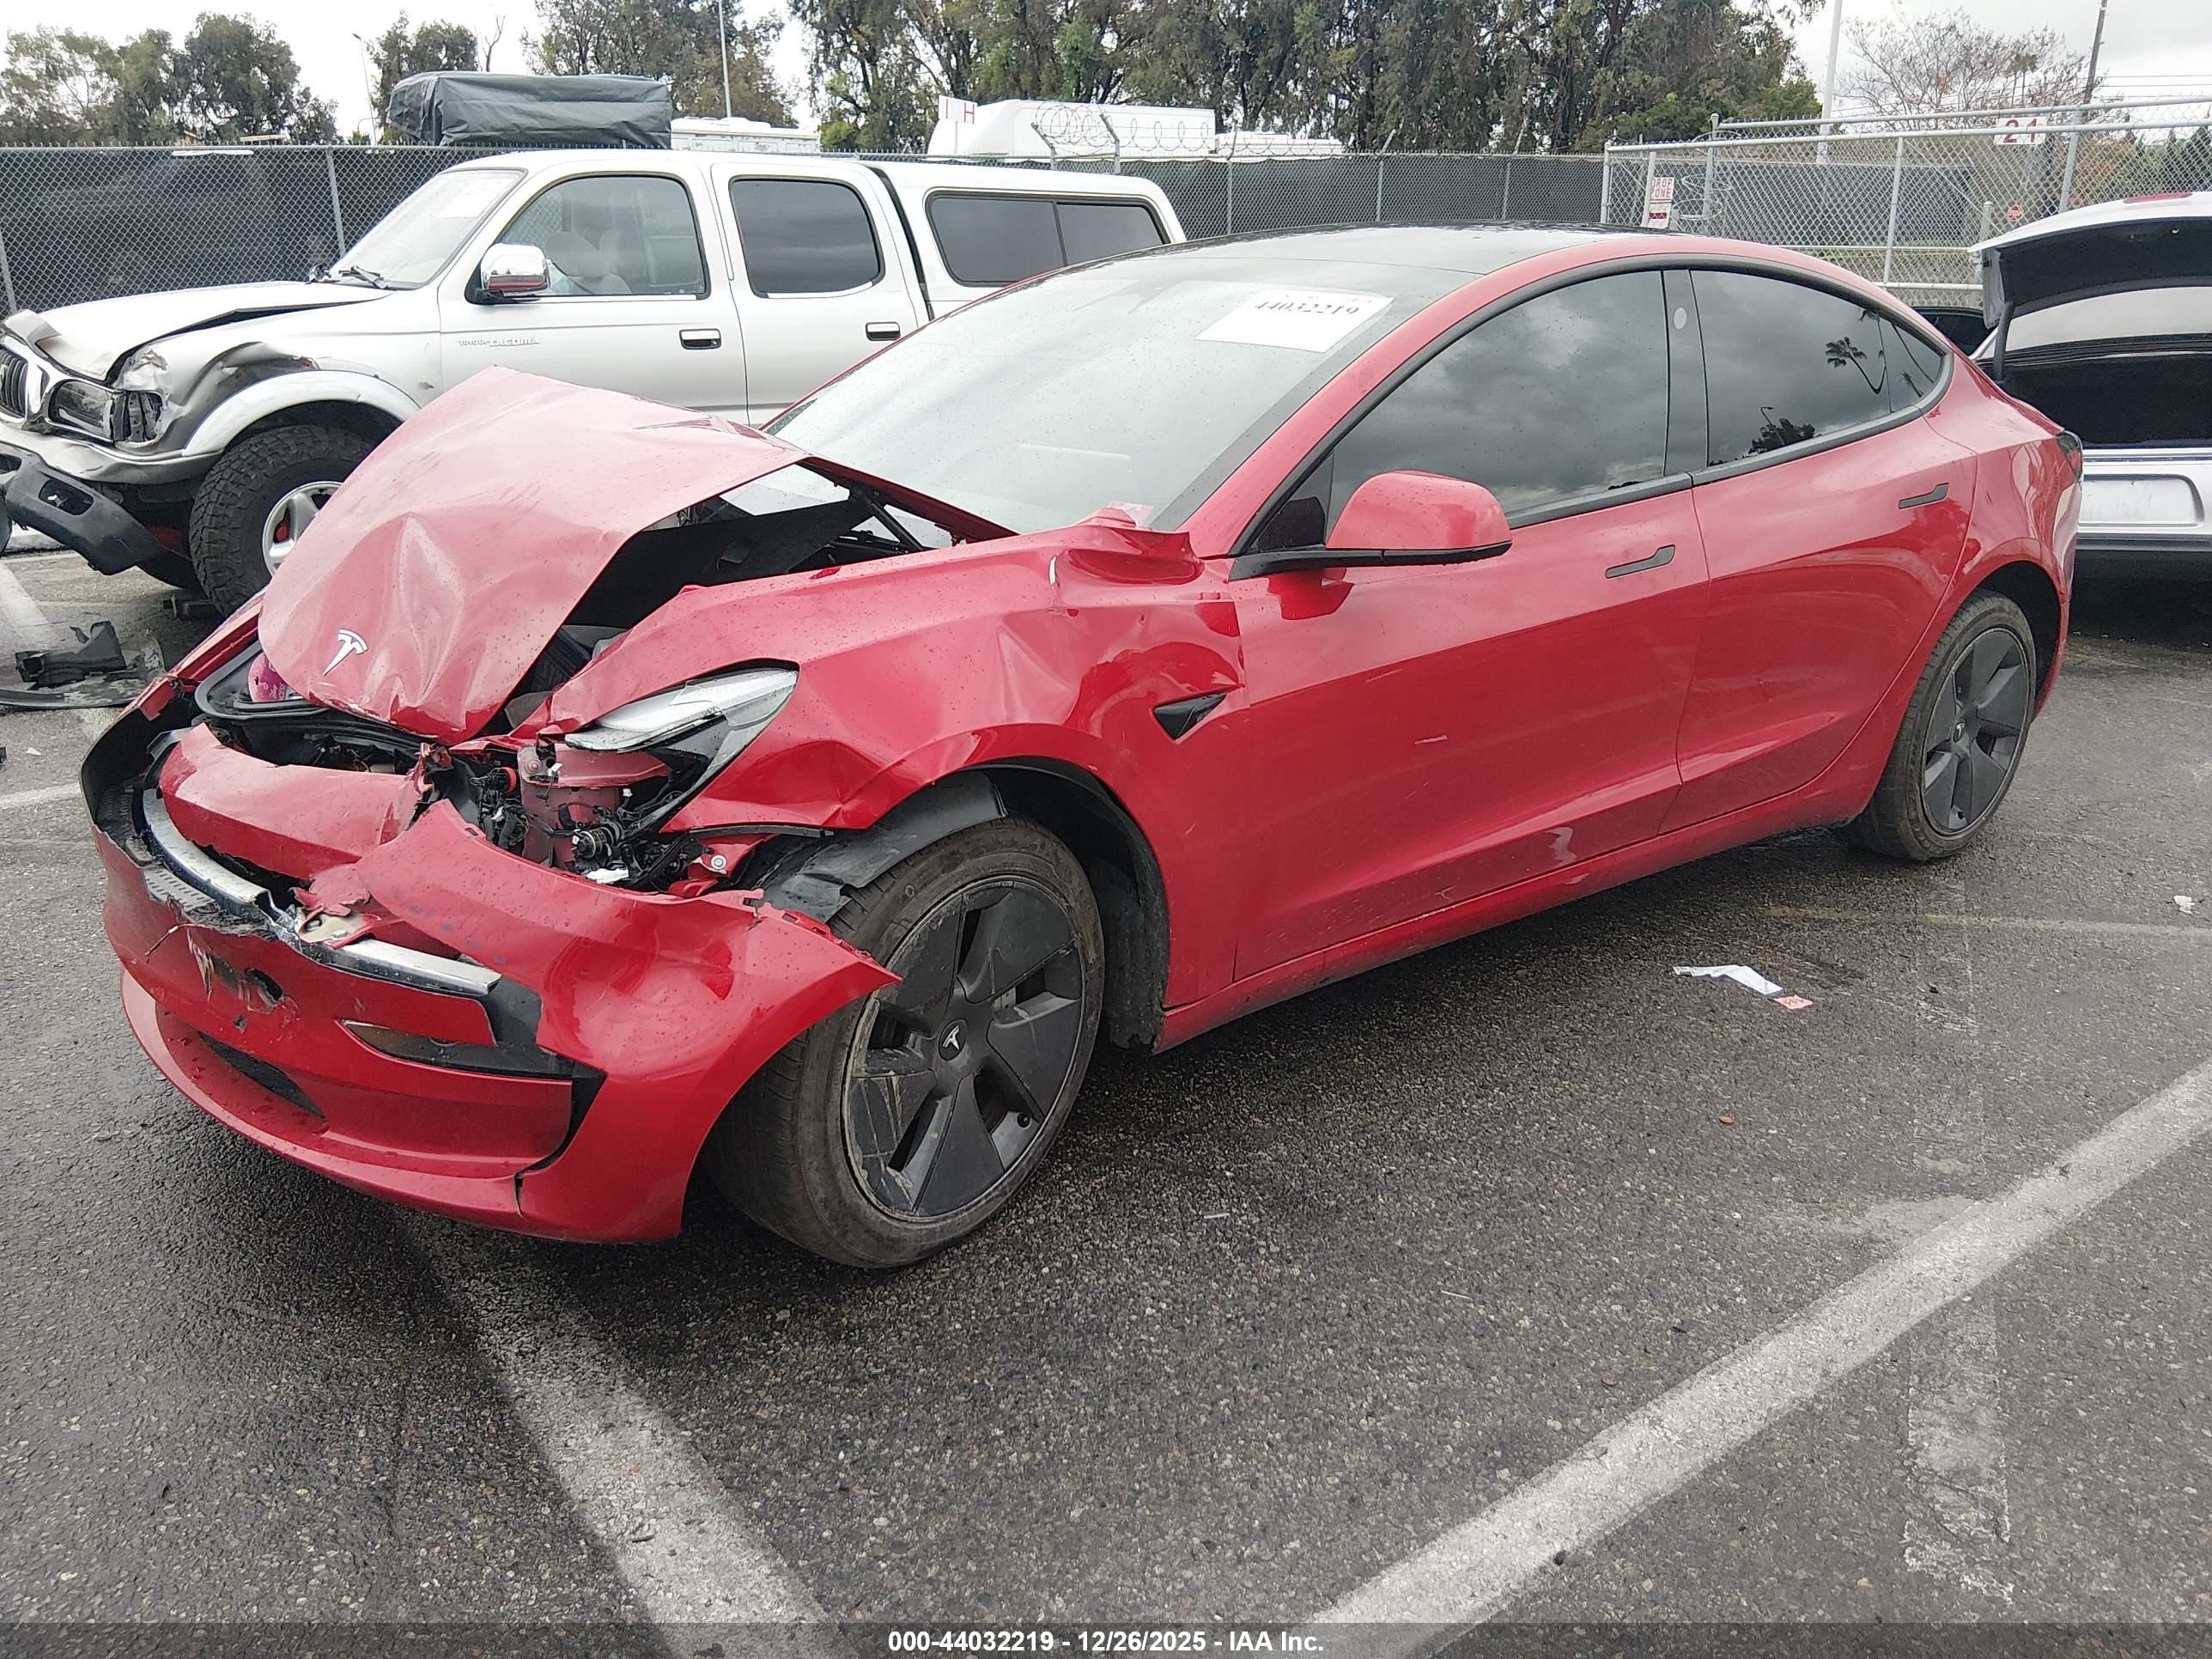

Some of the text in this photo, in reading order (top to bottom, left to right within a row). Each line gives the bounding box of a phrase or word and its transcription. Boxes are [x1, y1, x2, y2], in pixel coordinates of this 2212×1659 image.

[2002, 118, 2038, 143] 21
[1650, 178, 1673, 188] DROP
[1650, 188, 1671, 198] ZONE
[1254, 301, 1360, 315] 44032219
[488, 336, 541, 347] TACOMA
